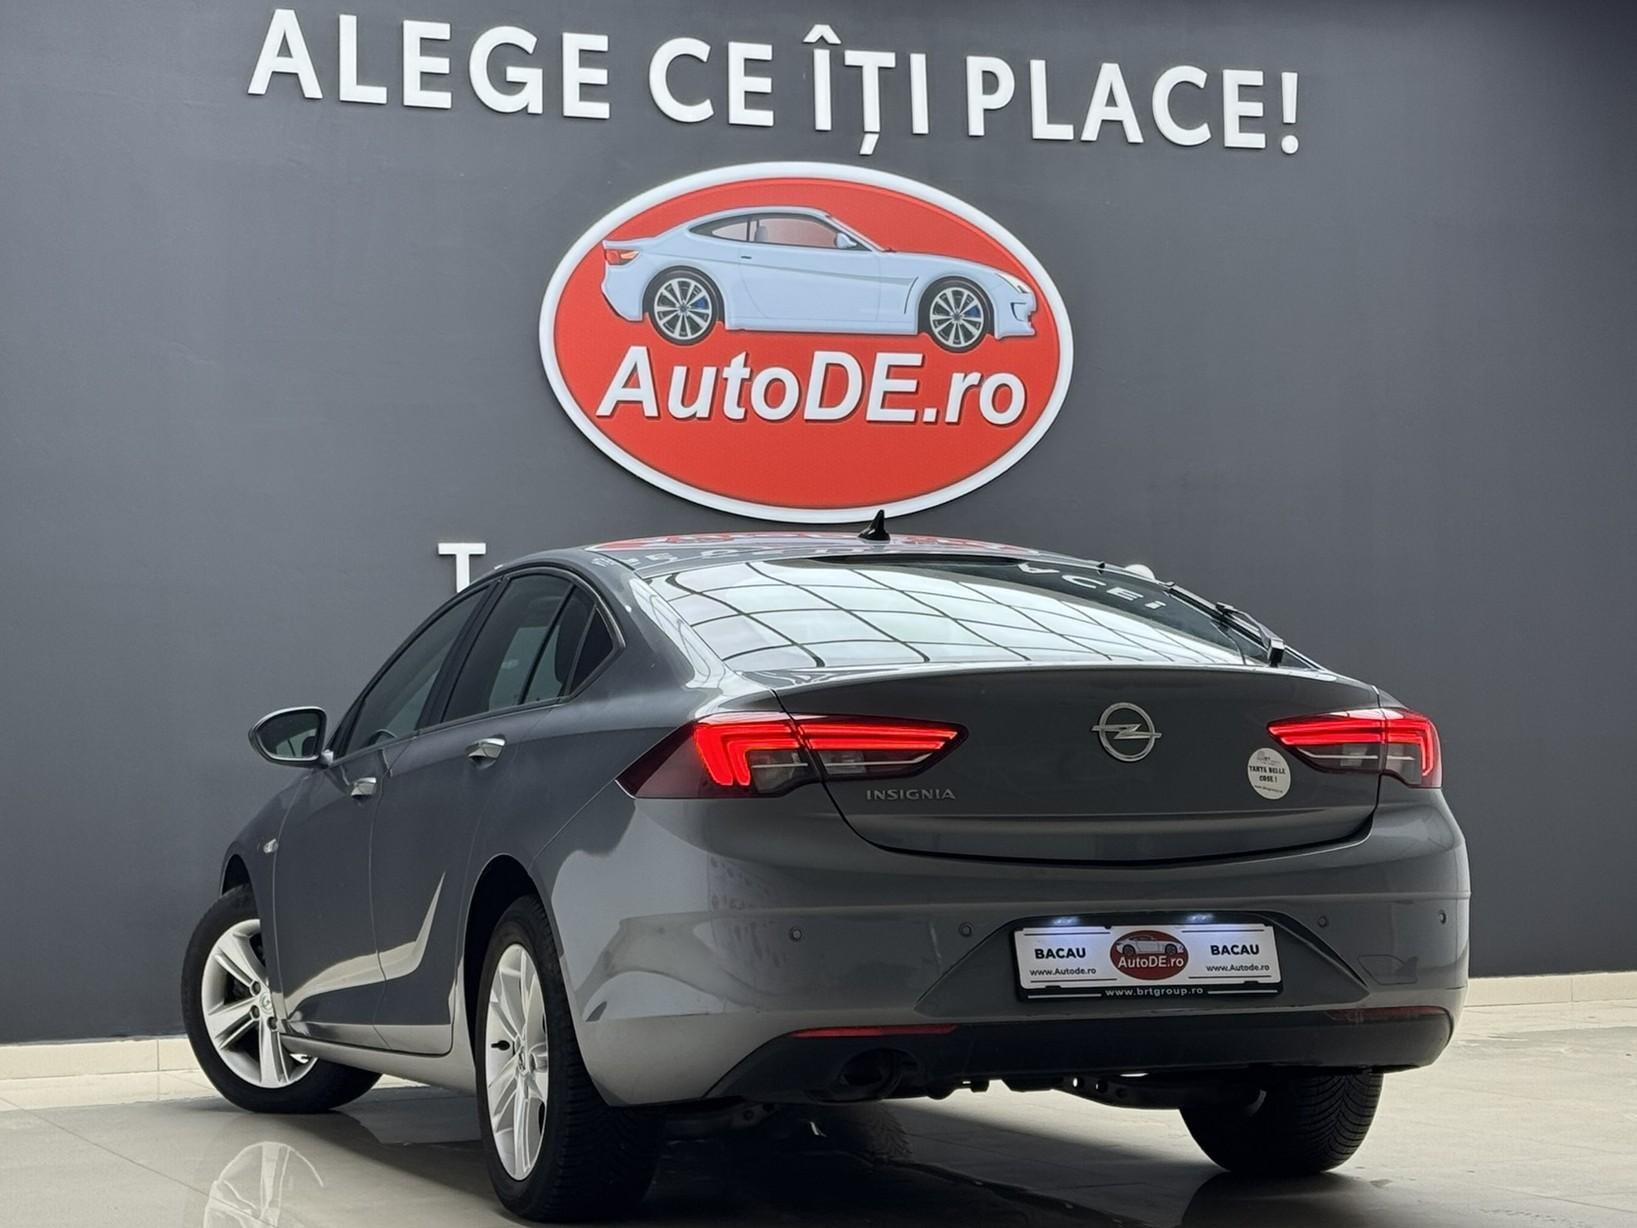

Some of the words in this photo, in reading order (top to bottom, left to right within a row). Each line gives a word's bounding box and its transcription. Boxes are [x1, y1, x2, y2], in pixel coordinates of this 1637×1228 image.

[247, 8, 611, 119] ALEGE
[650, 37, 774, 127] CE
[966, 55, 1300, 155] PLACE!
[595, 345, 1026, 425] AutoDE.ro
[866, 788, 956, 800] INSIGNIA
[1034, 947, 1086, 959] BACAU
[1210, 944, 1260, 956] BACAU
[1117, 955, 1184, 969] AutoDE.ro
[1206, 963, 1270, 972] www.Autode.ro
[1029, 967, 1097, 976] www.Autode.ro
[1104, 986, 1204, 997] www.brtgroup.ro
